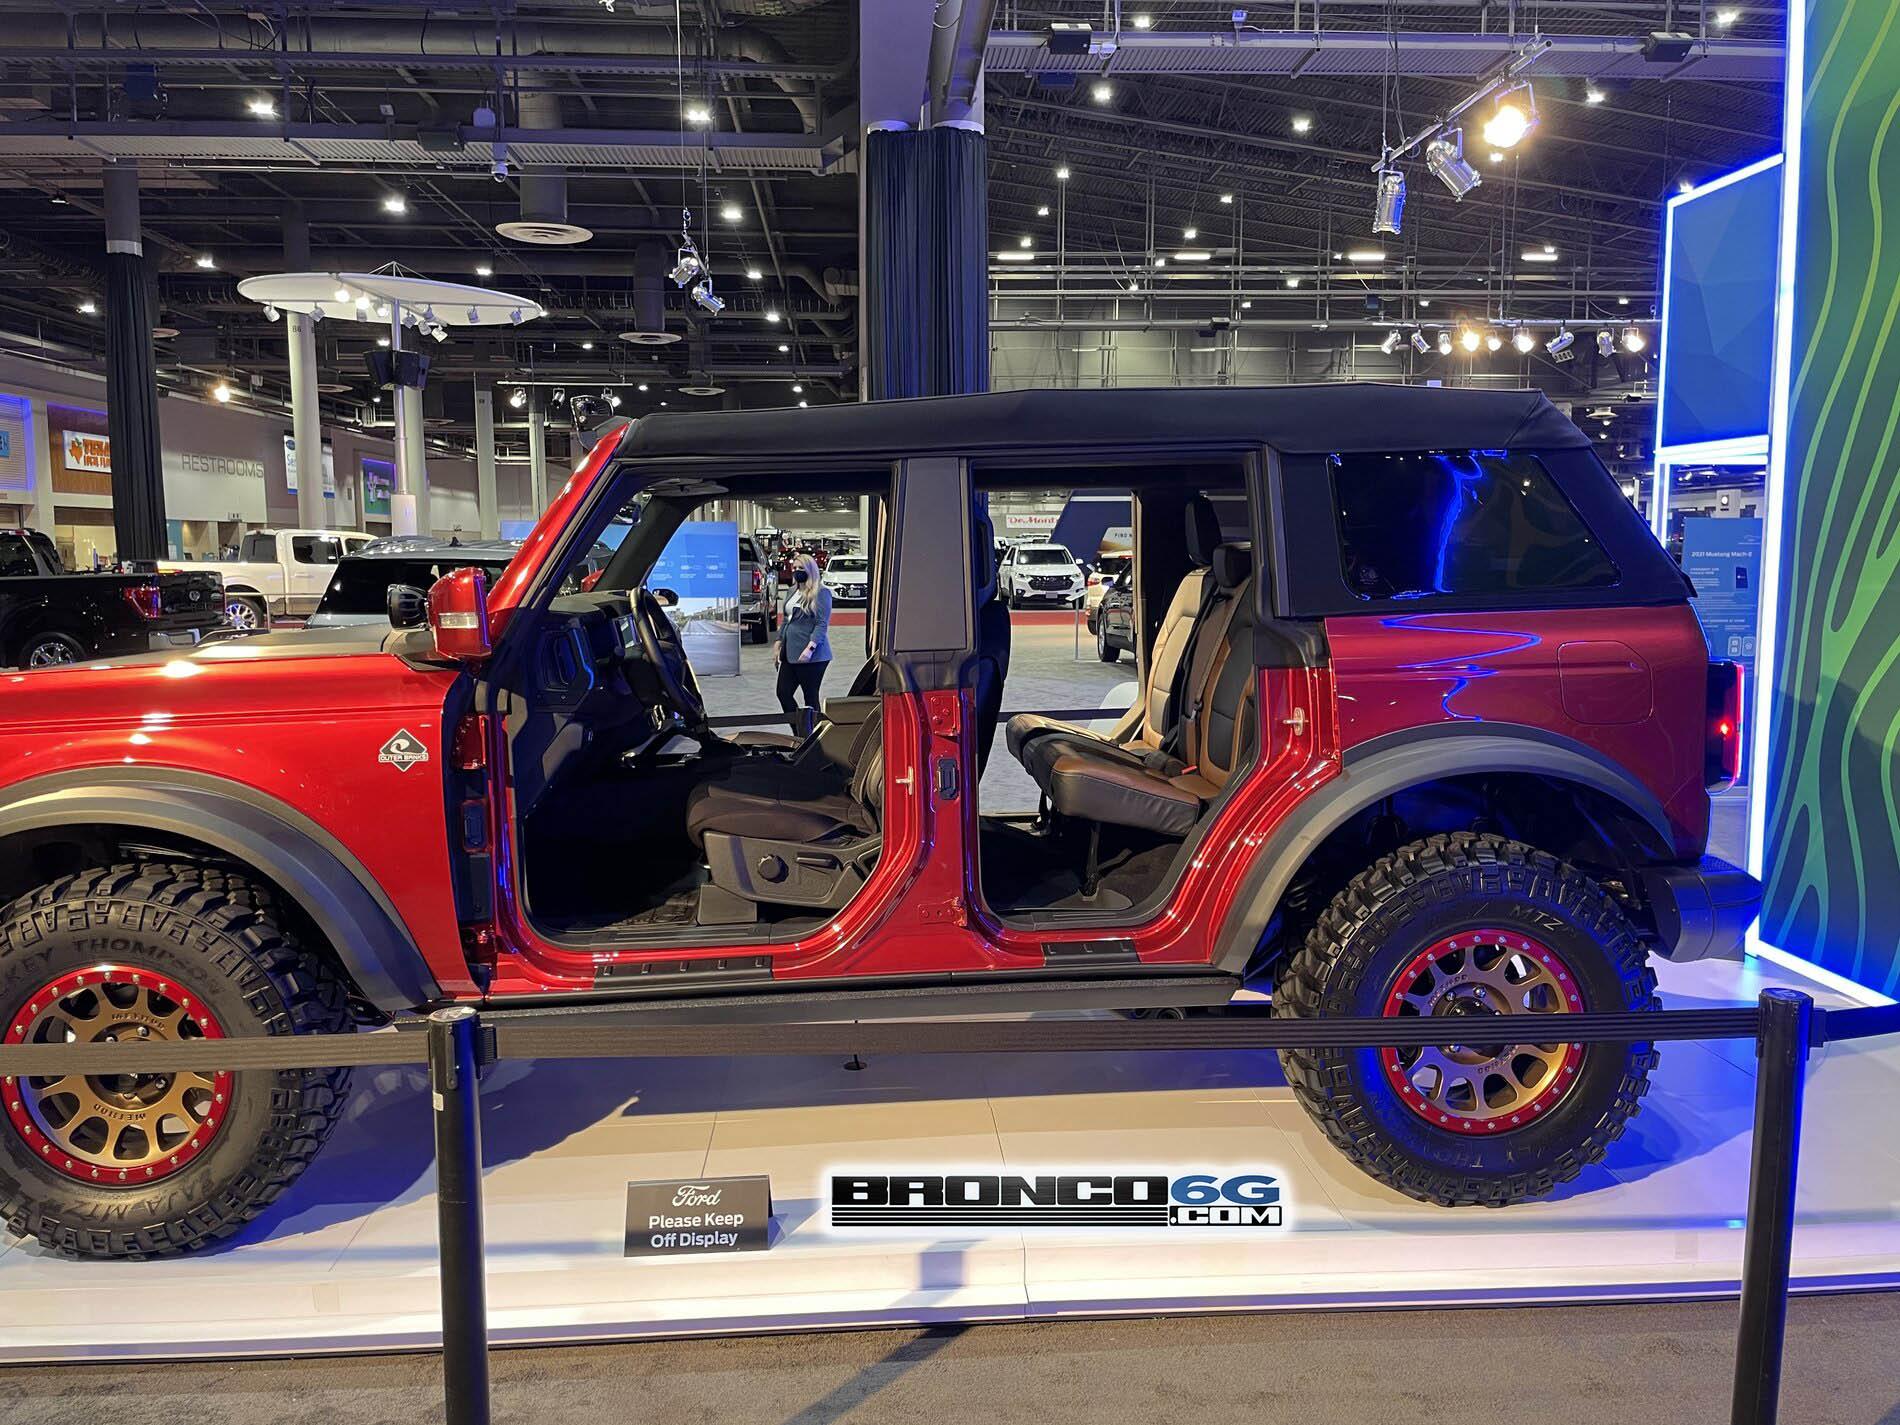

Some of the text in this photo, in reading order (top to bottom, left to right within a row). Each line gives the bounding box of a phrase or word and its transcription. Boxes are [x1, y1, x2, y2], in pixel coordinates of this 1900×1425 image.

[181, 453, 265, 479] RESTROOMS
[1705, 551, 1730, 559] Mustang
[672, 1184, 723, 1207] Ford
[648, 1212, 744, 1230] Please Keep
[650, 1230, 739, 1249] Off Display
